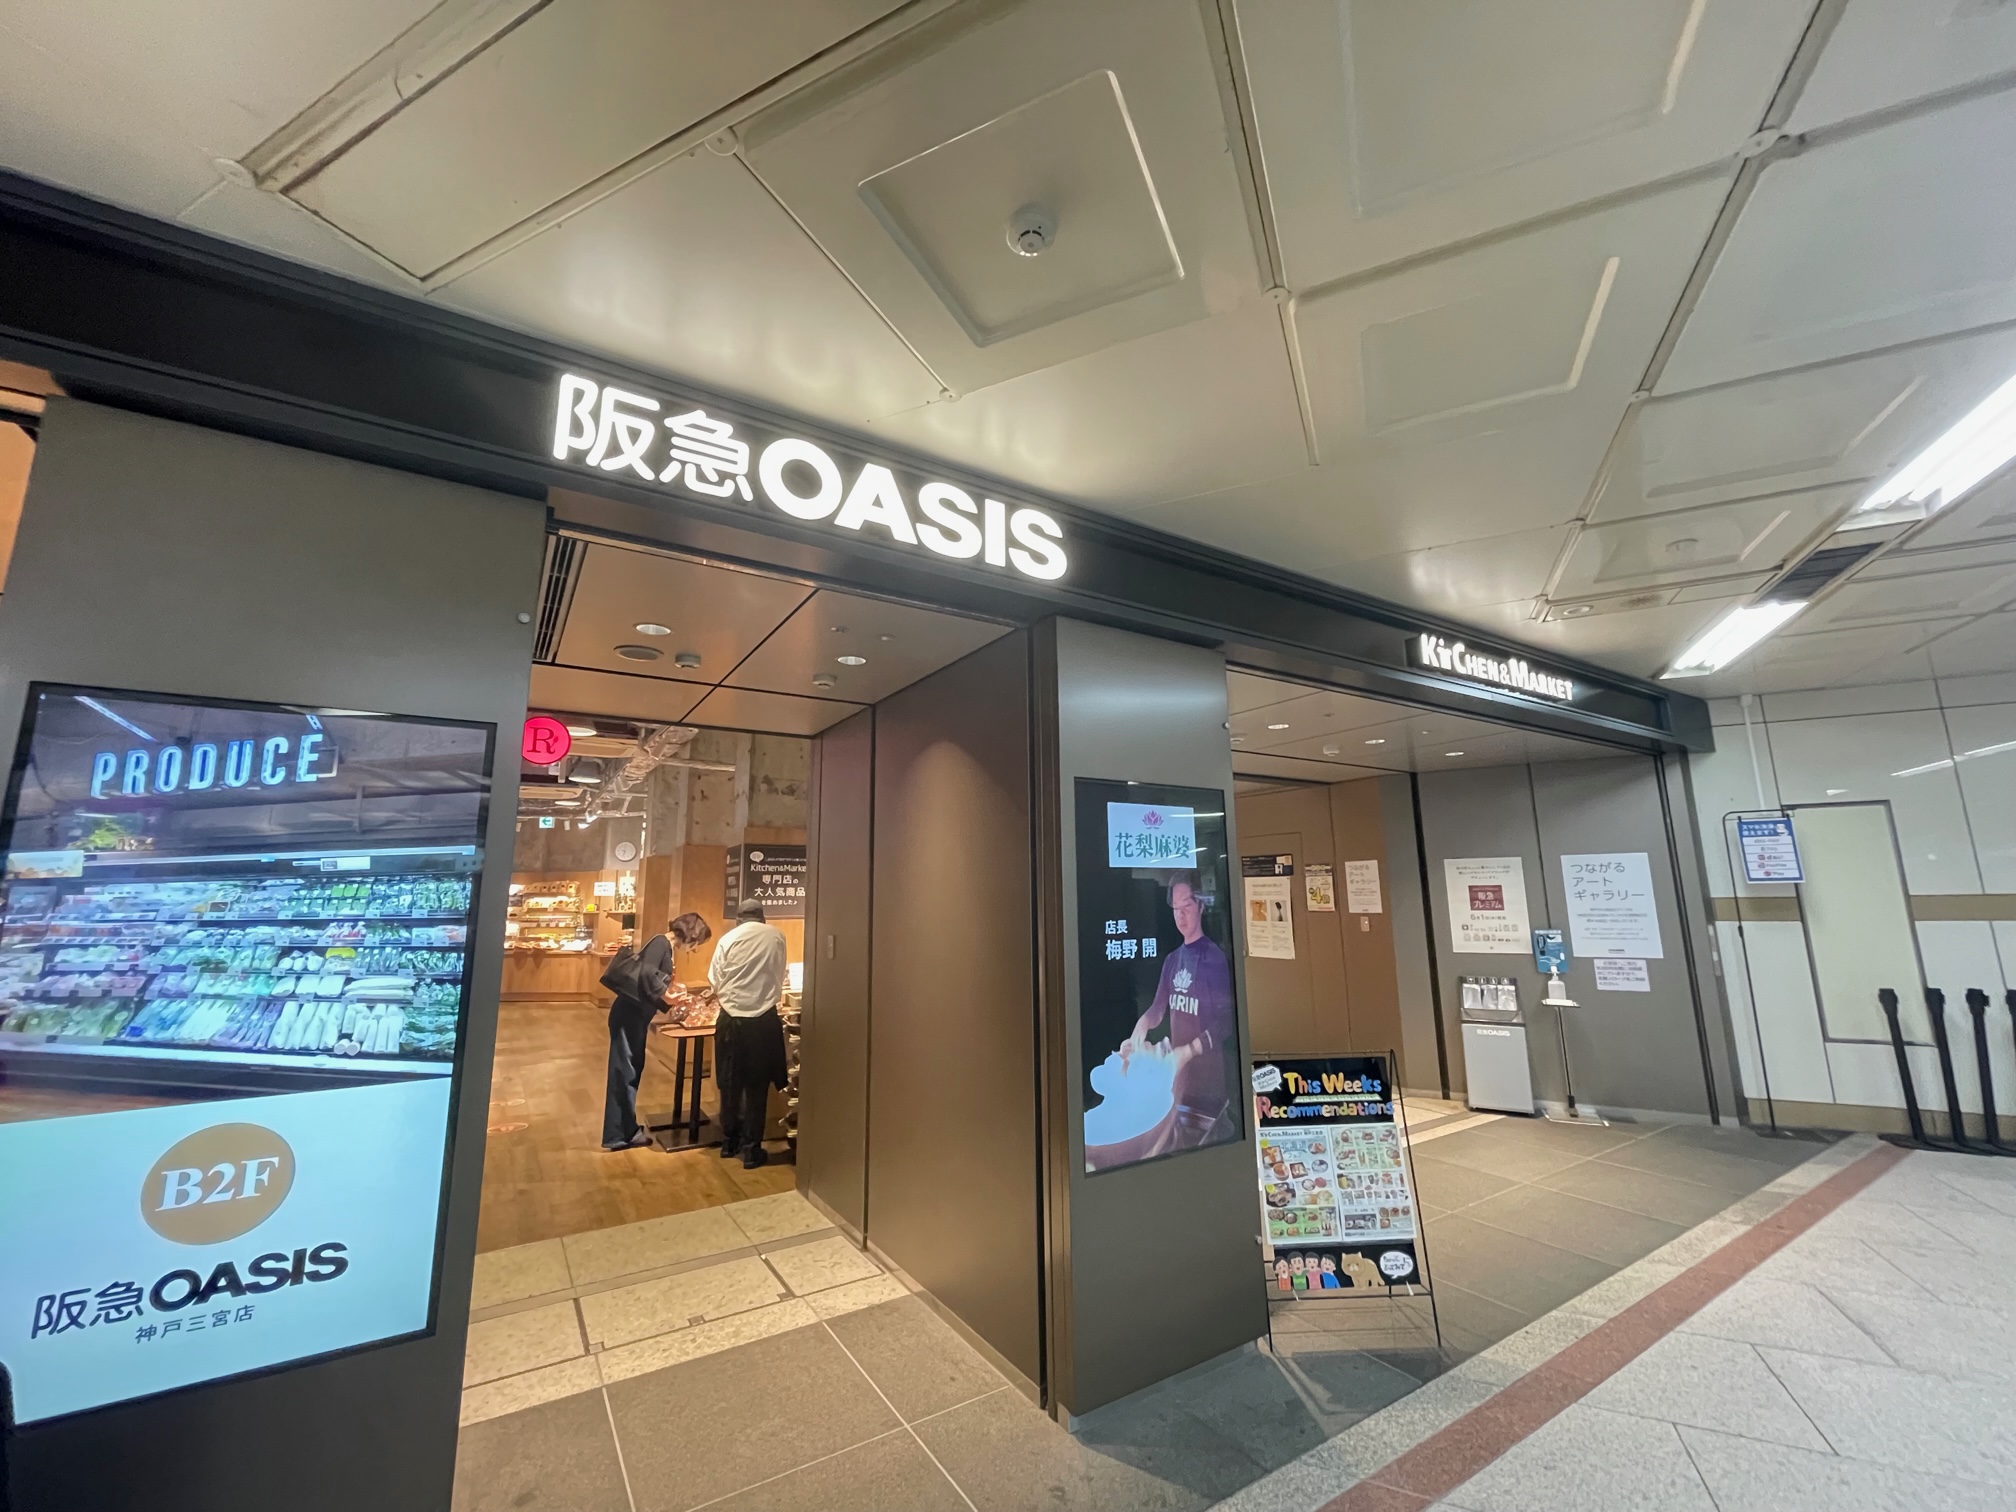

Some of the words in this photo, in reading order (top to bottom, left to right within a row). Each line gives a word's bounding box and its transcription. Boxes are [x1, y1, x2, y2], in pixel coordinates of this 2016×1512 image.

[552, 373, 1068, 581] 阪急OASIS
[526, 727, 559, 755] R
[90, 733, 324, 799] PRODUCE
[1114, 832, 1192, 860] 花梨麻婆
[750, 863, 807, 873] Kitchen&Marke
[762, 874, 799, 885] 専門店の
[1570, 862, 1626, 874] つながる
[754, 886, 806, 897] 大人気商品
[1572, 876, 1613, 888] アート
[1473, 900, 1502, 909] プレミアム
[1573, 889, 1645, 901] ギャラリー
[1105, 919, 1128, 935] 店長
[1105, 939, 1138, 960] 梅野
[1142, 937, 1157, 958] 開
[1283, 1072, 1321, 1095] This
[1321, 1072, 1381, 1094] Weeks
[1255, 1095, 1394, 1120] Recommendations
[155, 1156, 280, 1212] B2F
[30, 1242, 349, 1340] 阪急OASIS
[135, 1305, 255, 1344] 神戸三宮店
